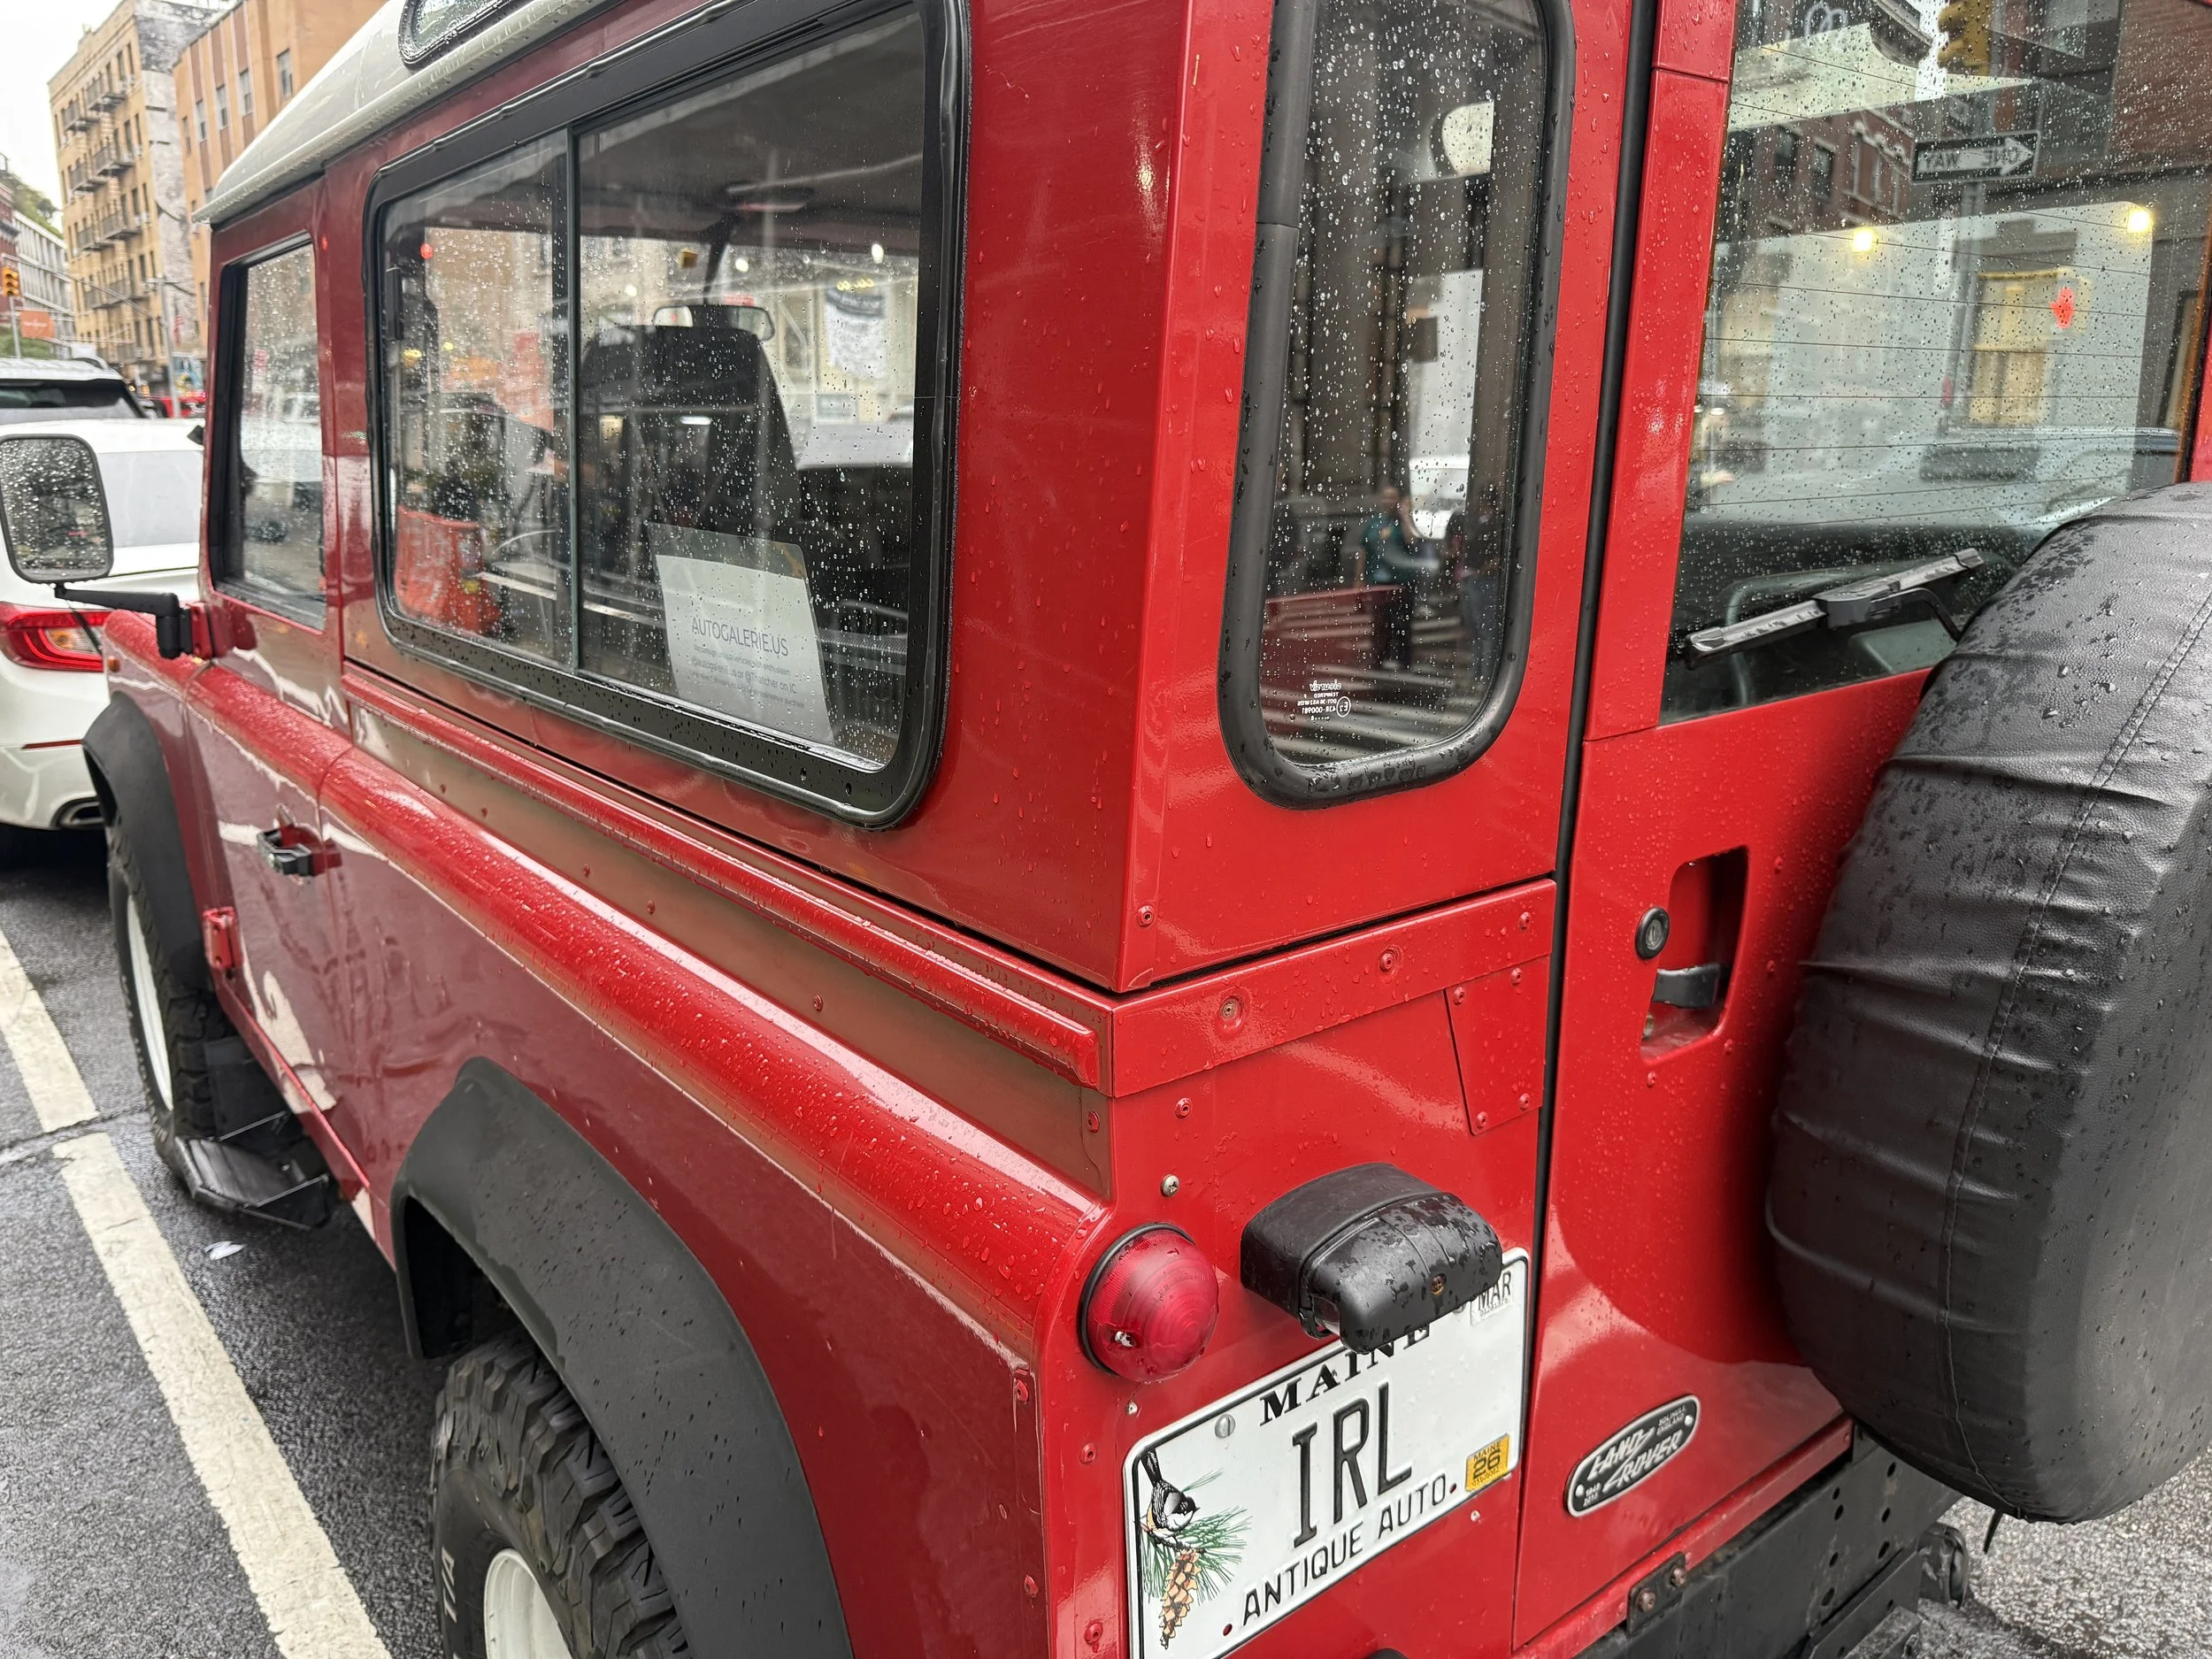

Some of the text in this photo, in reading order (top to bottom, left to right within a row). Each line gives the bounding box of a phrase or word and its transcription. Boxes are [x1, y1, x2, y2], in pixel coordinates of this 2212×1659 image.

[692, 618, 788, 657] AUTOGALERIE.US
[1478, 1271, 1511, 1311] MAR
[1293, 1381, 1412, 1548] IRL
[1472, 1448, 1501, 1480] 26
[1473, 1441, 1502, 1461] MAINE
[1587, 1427, 1648, 1480] LAND
[1617, 1429, 1683, 1488] ROVER
[1243, 1473, 1447, 1626] ANTIQUE AUTO
[442, 1546, 457, 1624] T/A
